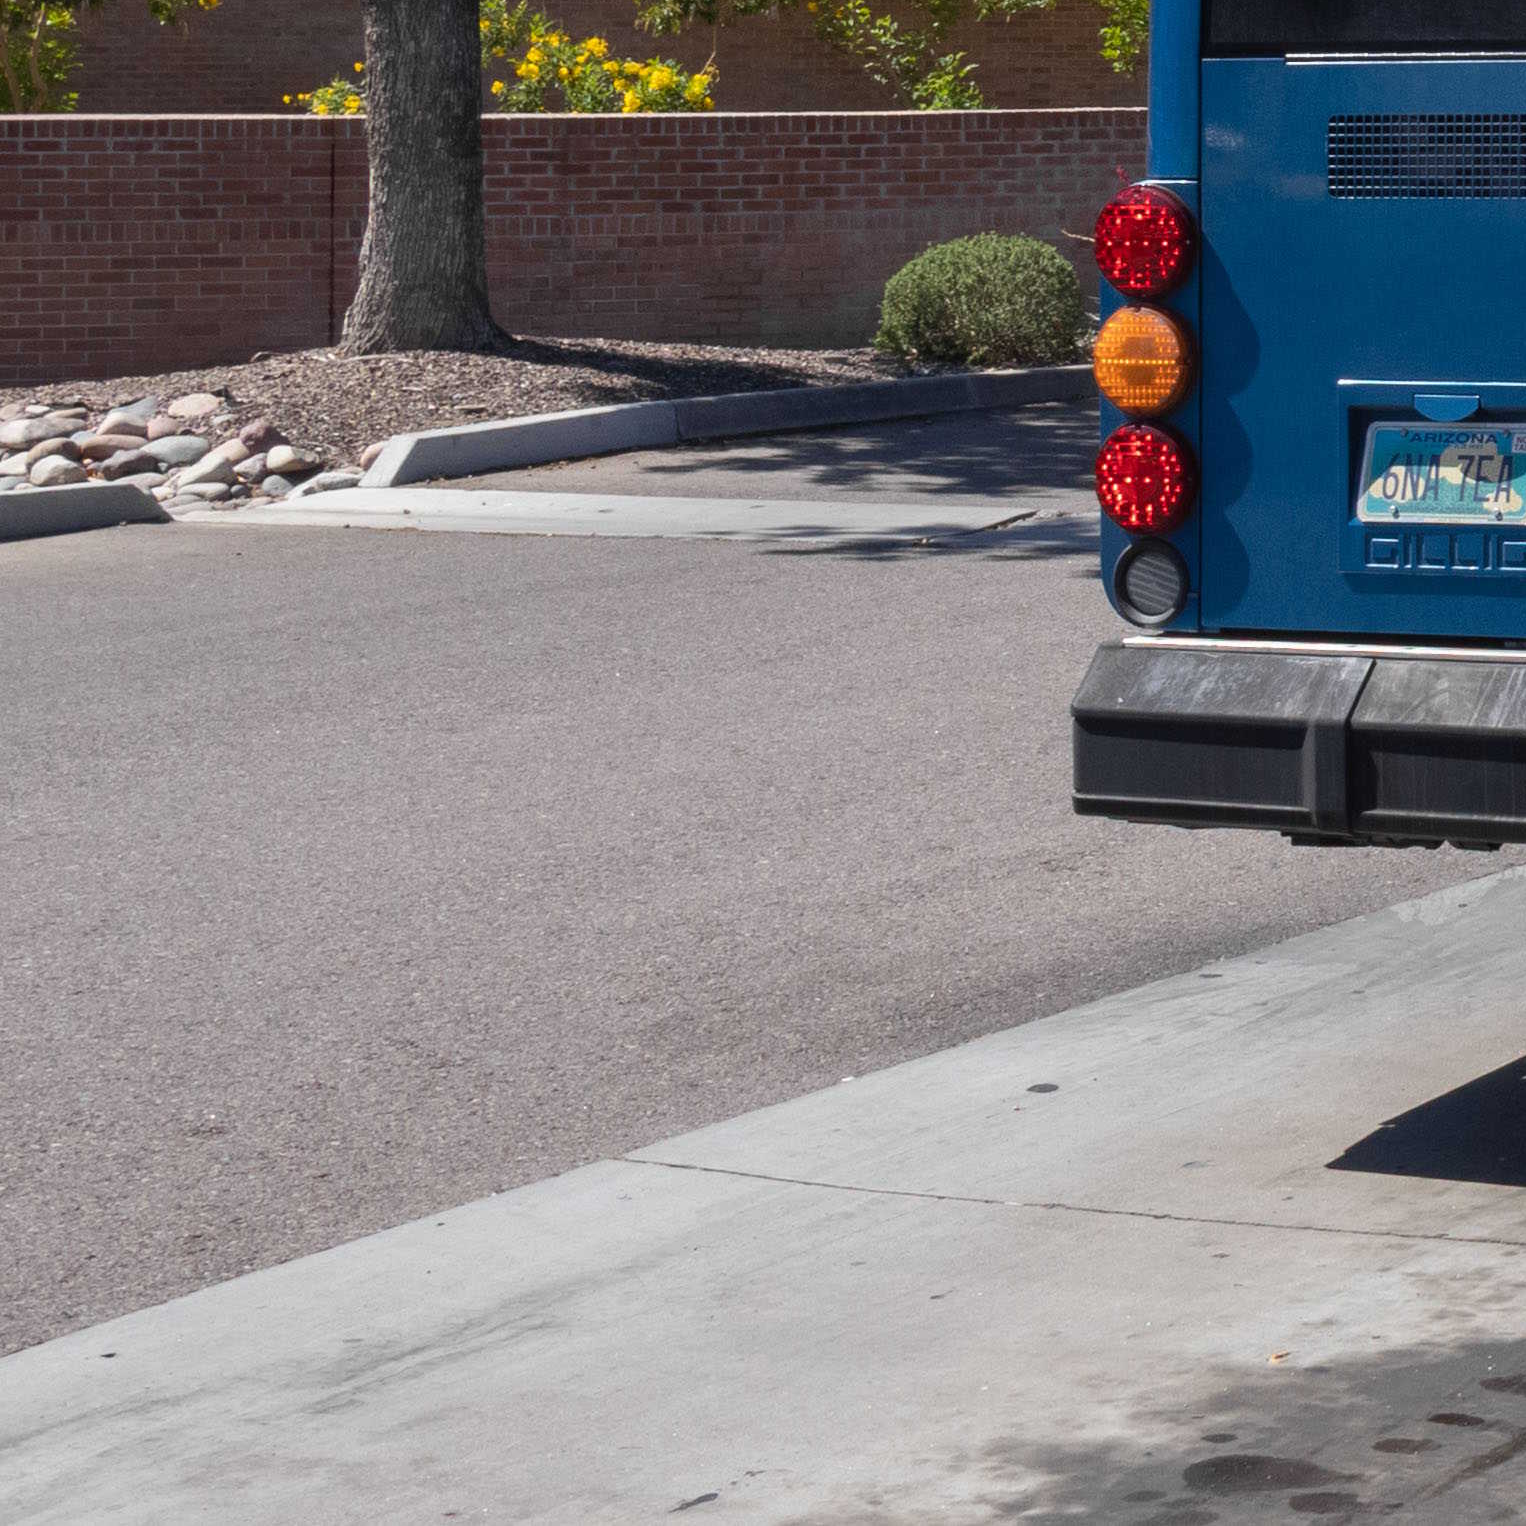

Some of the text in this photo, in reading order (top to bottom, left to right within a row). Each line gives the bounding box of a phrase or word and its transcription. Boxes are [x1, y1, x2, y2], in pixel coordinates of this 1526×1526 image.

[1409, 432, 1498, 445] ARIZONA
[1382, 452, 1514, 503] 6NA 7EA
